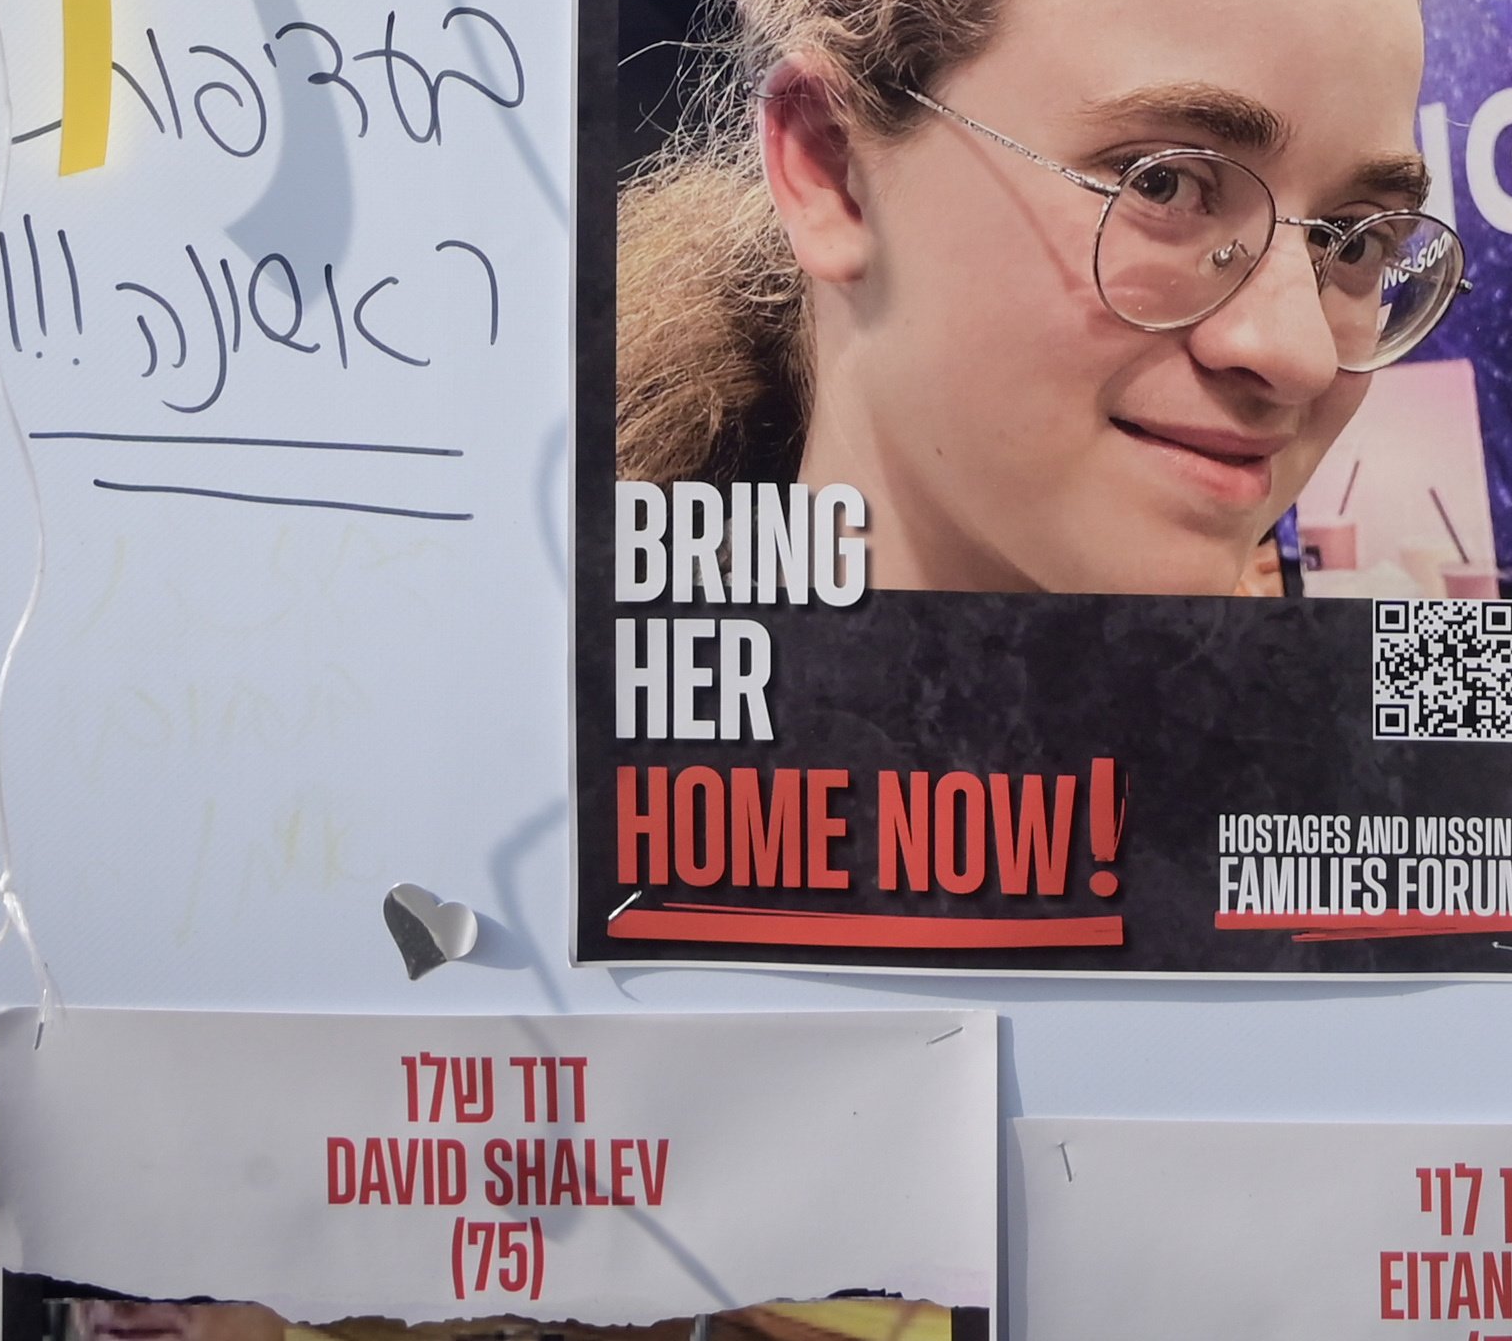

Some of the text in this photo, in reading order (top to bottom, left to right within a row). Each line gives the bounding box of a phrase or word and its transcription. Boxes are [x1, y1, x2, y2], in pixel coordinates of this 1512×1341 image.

[615, 482, 868, 607] BRING
[616, 619, 773, 740] HER
[617, 757, 1126, 897] HOME NOW!
[402, 1053, 588, 1123] דוד שלו
[328, 1137, 669, 1206] DAVID SHALEV
[1417, 1163, 1483, 1236] לוי
[453, 1217, 545, 1300] (75)
[1381, 1252, 1512, 1320] EITAN
